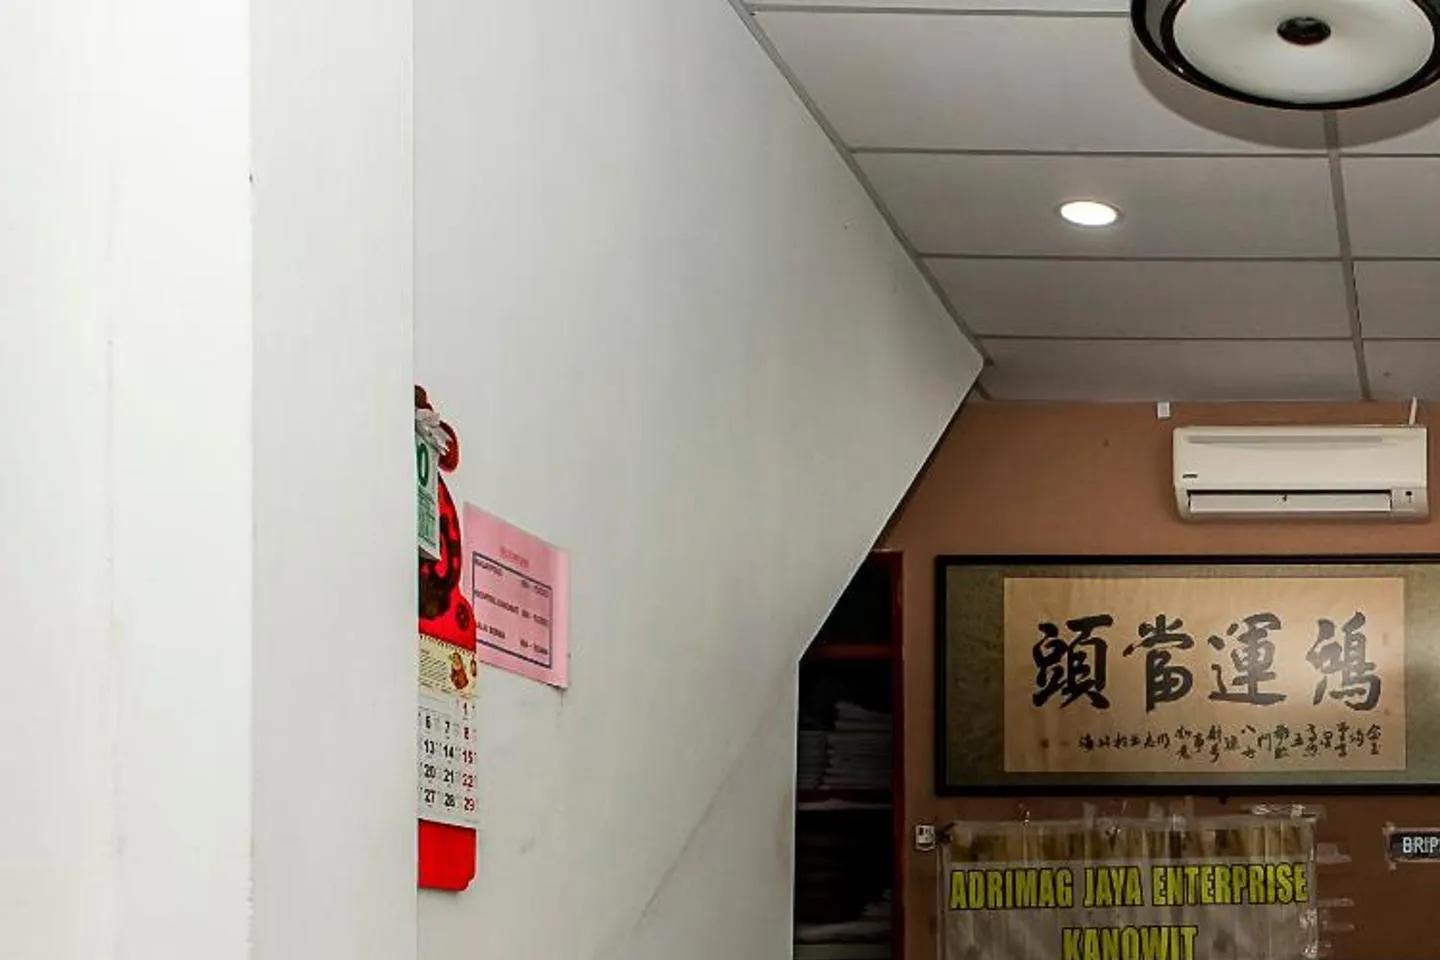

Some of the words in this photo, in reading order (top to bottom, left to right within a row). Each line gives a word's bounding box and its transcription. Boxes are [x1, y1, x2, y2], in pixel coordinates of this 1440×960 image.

[423, 738, 435, 755] 13
[443, 743, 454, 759] 14
[462, 750, 473, 764] 15
[423, 763, 436, 779] 20
[442, 768, 454, 784] 21
[462, 773, 473, 788] 22
[423, 788, 436, 804] 27
[950, 867, 1074, 911] ADRIMAG
[1083, 865, 1145, 908] JAYA
[1151, 862, 1309, 907] ENTERPRISE
